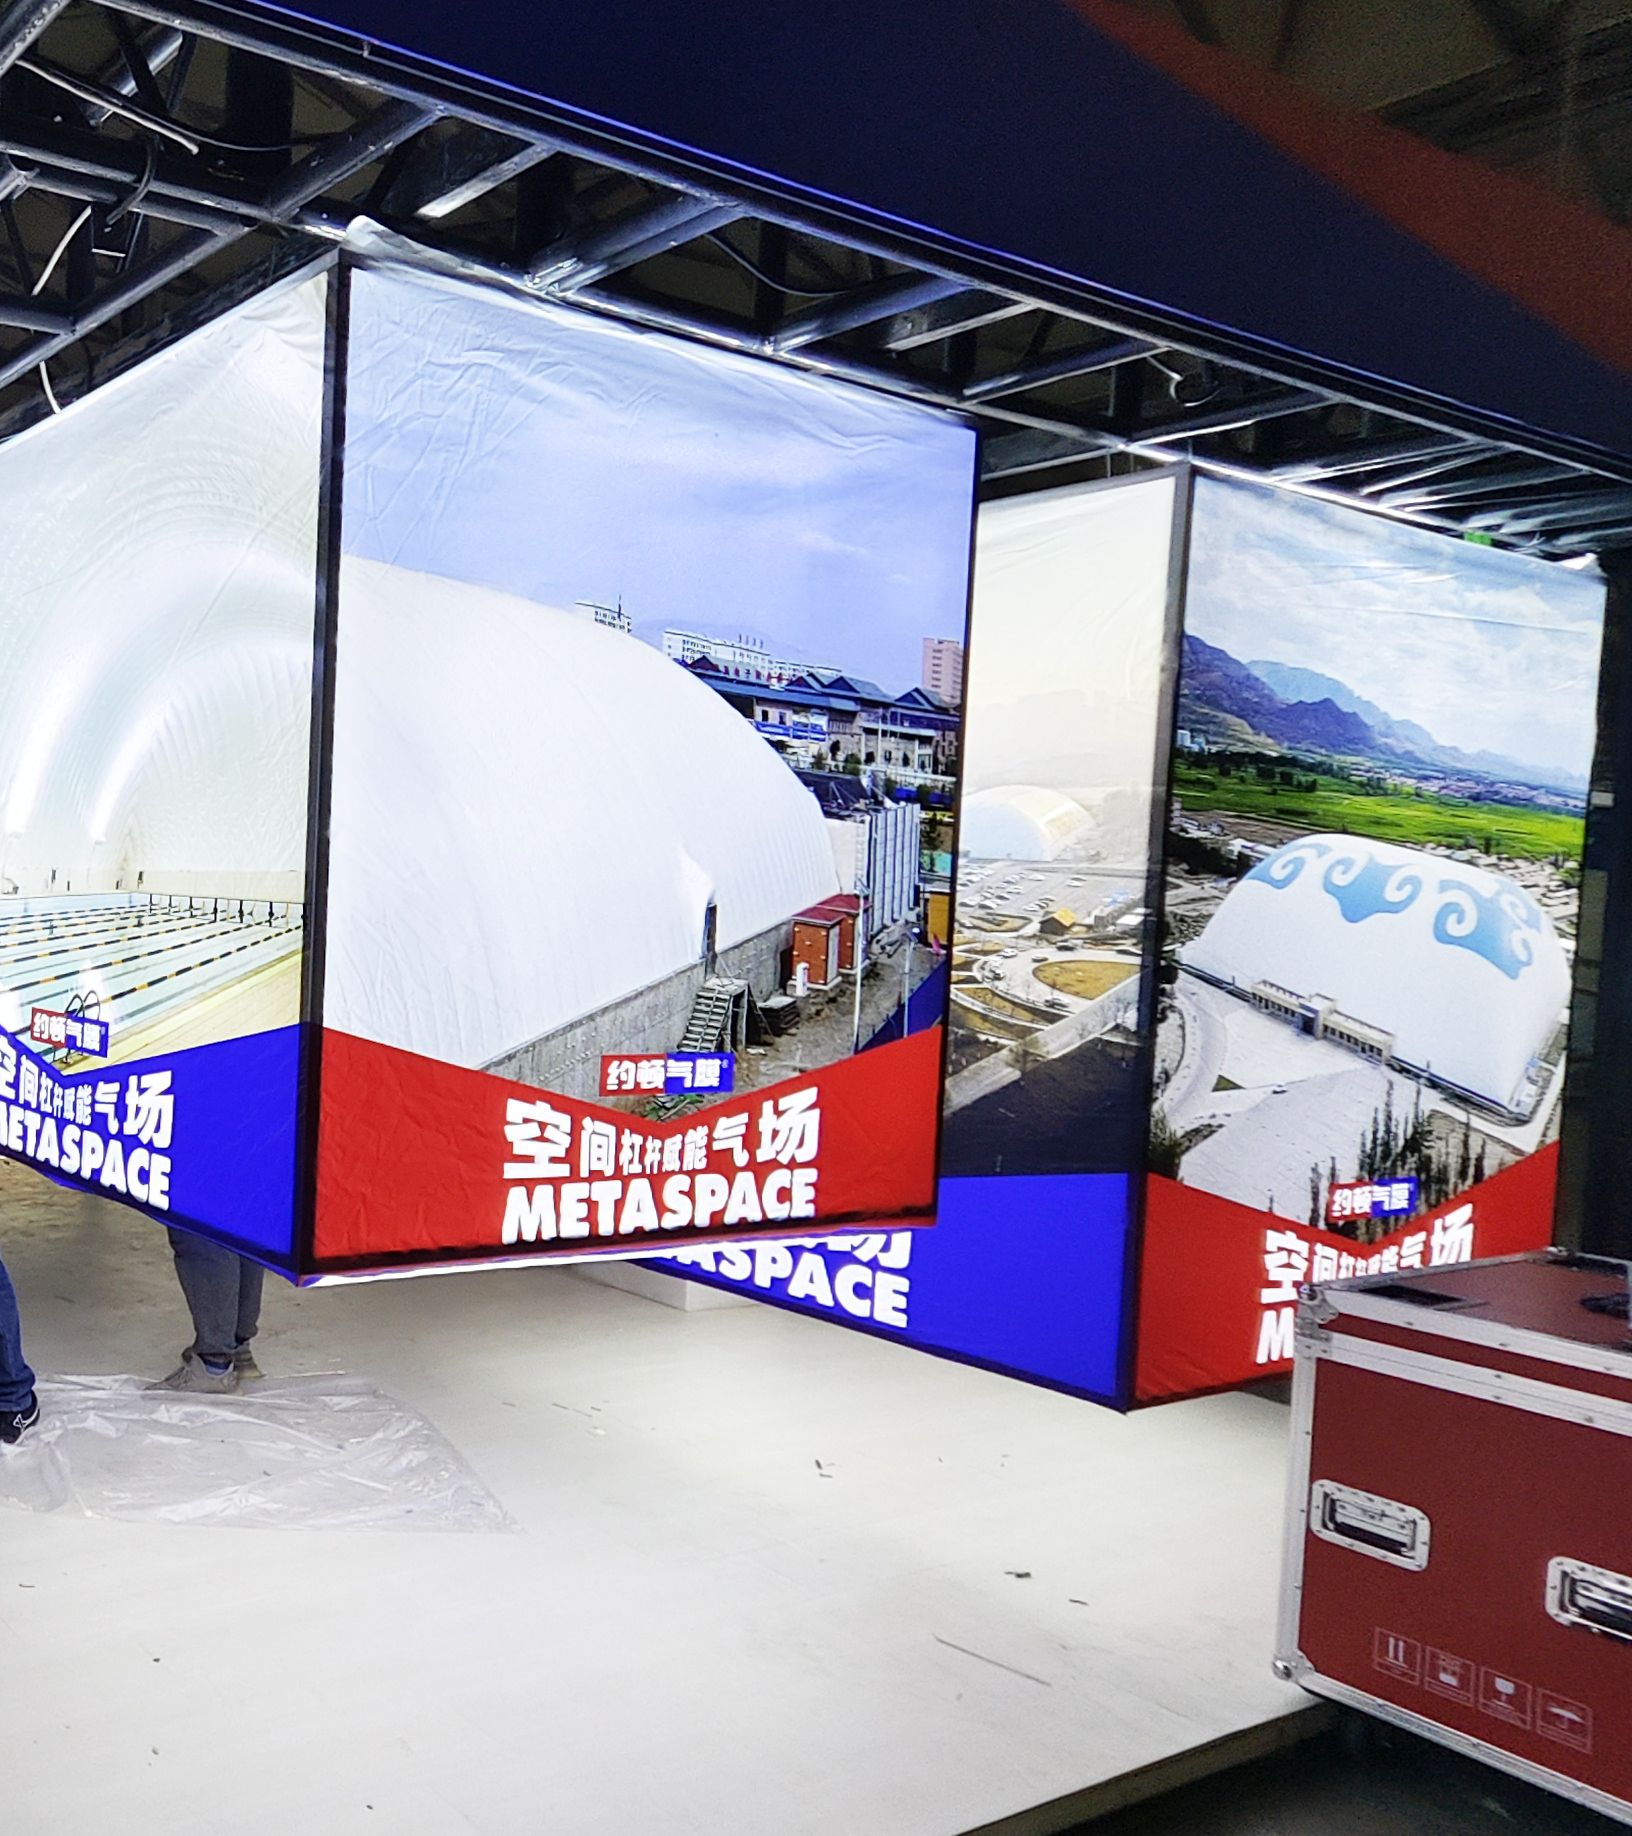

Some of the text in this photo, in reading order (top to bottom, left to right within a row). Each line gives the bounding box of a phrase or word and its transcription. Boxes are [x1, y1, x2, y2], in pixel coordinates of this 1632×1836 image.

[502, 1086, 821, 1179] 空间杠杆赋能气场
[501, 1168, 818, 1245] METASPACE
